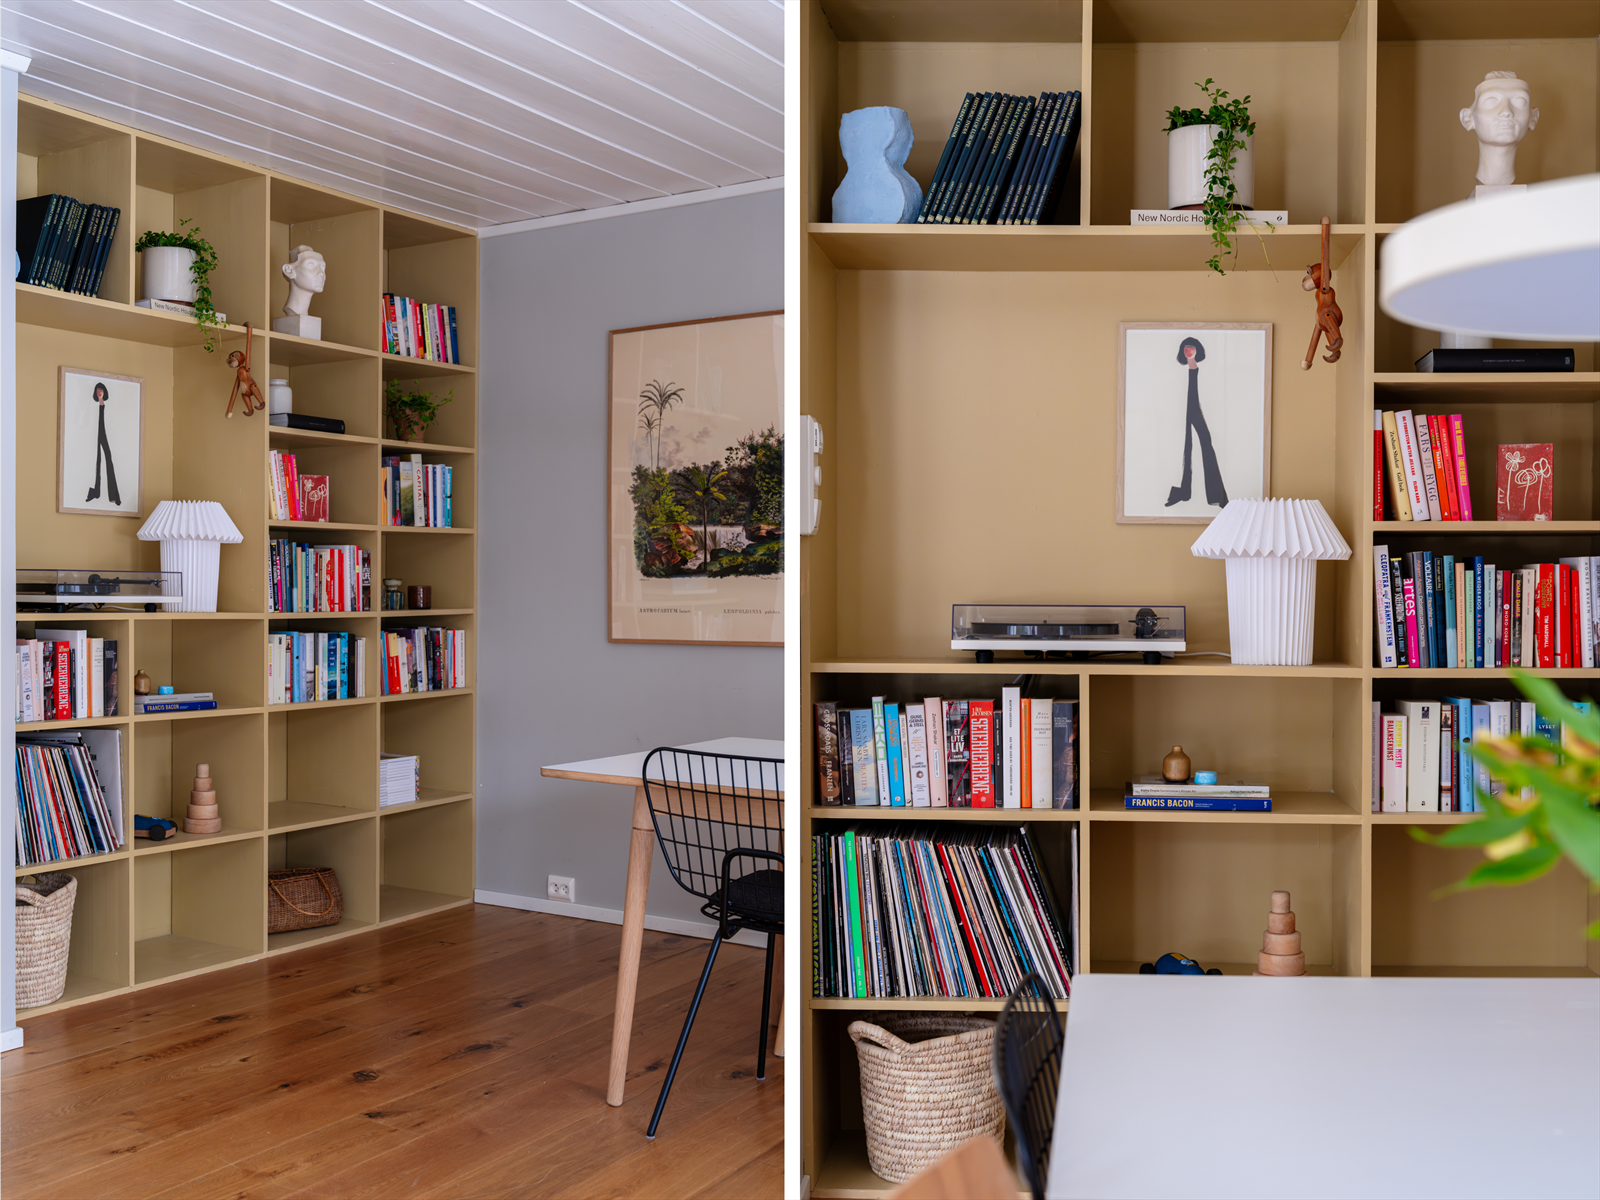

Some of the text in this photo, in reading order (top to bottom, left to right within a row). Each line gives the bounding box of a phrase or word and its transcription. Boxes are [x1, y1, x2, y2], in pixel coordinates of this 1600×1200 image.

[1160, 214, 1189, 222] Nordic
[154, 302, 180, 313] New Nordic
[1419, 424, 1437, 502] FARS RYGG
[1380, 554, 1389, 588] CLEOPATRA
[1424, 561, 1432, 594] VOLTAIRE
[1403, 579, 1416, 616] artes
[1383, 602, 1393, 646] FRANKENSTEIN
[58, 653, 68, 710] SEIERHERRENE
[972, 707, 993, 716] JACOBSEN
[855, 716, 863, 762] CHRISTENSEN
[873, 701, 886, 761] EKKO
[951, 742, 965, 753] LIV
[971, 718, 989, 794] SEIERHERRENE
[1132, 798, 1165, 807] FRANCIS
